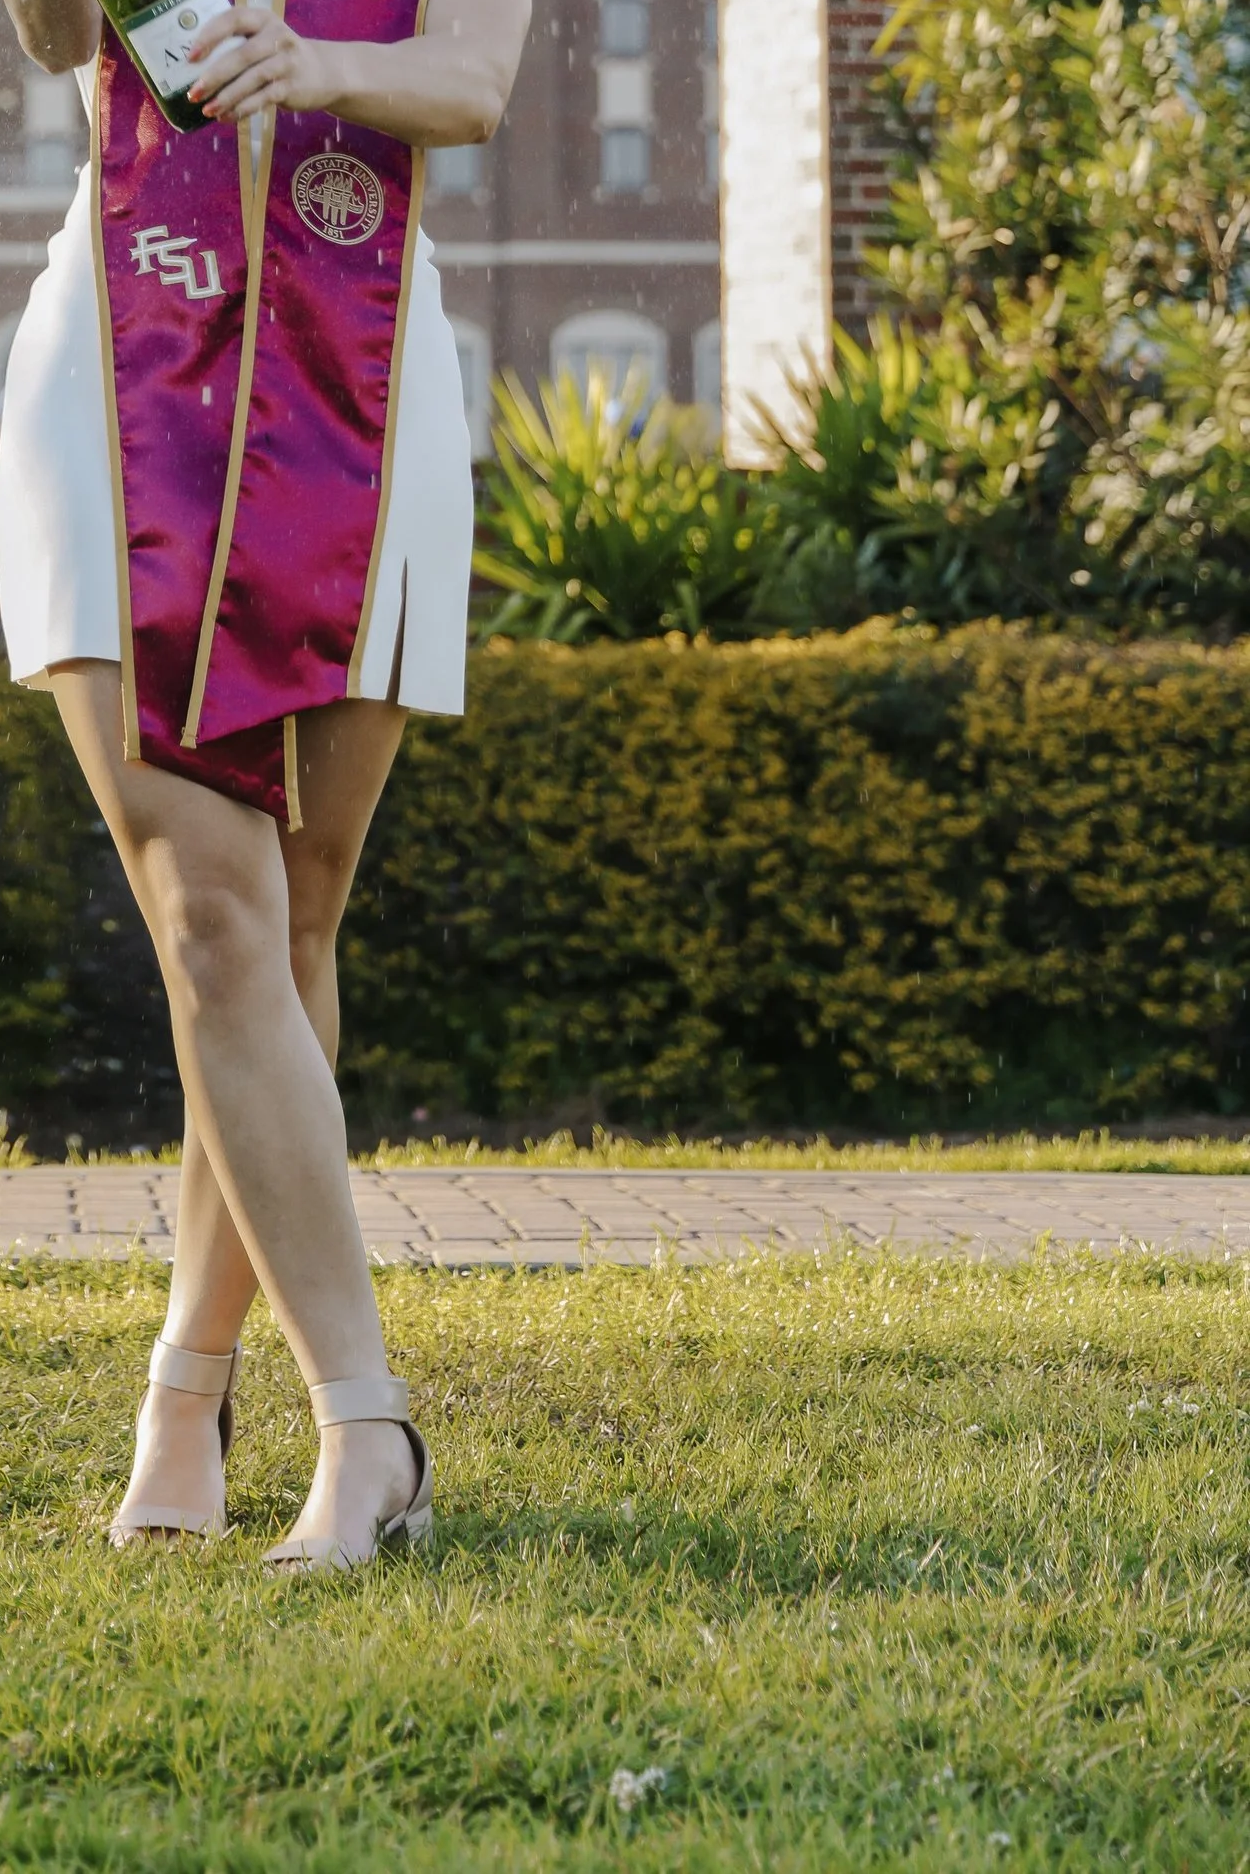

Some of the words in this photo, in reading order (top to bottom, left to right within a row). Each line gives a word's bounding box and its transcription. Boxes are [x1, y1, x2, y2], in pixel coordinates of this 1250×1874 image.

[297, 166, 316, 213] FLORIDA
[315, 159, 351, 171] STATE
[352, 166, 378, 232] UNIVERSITY
[128, 224, 228, 300] FSU
[322, 225, 345, 240] 1851
